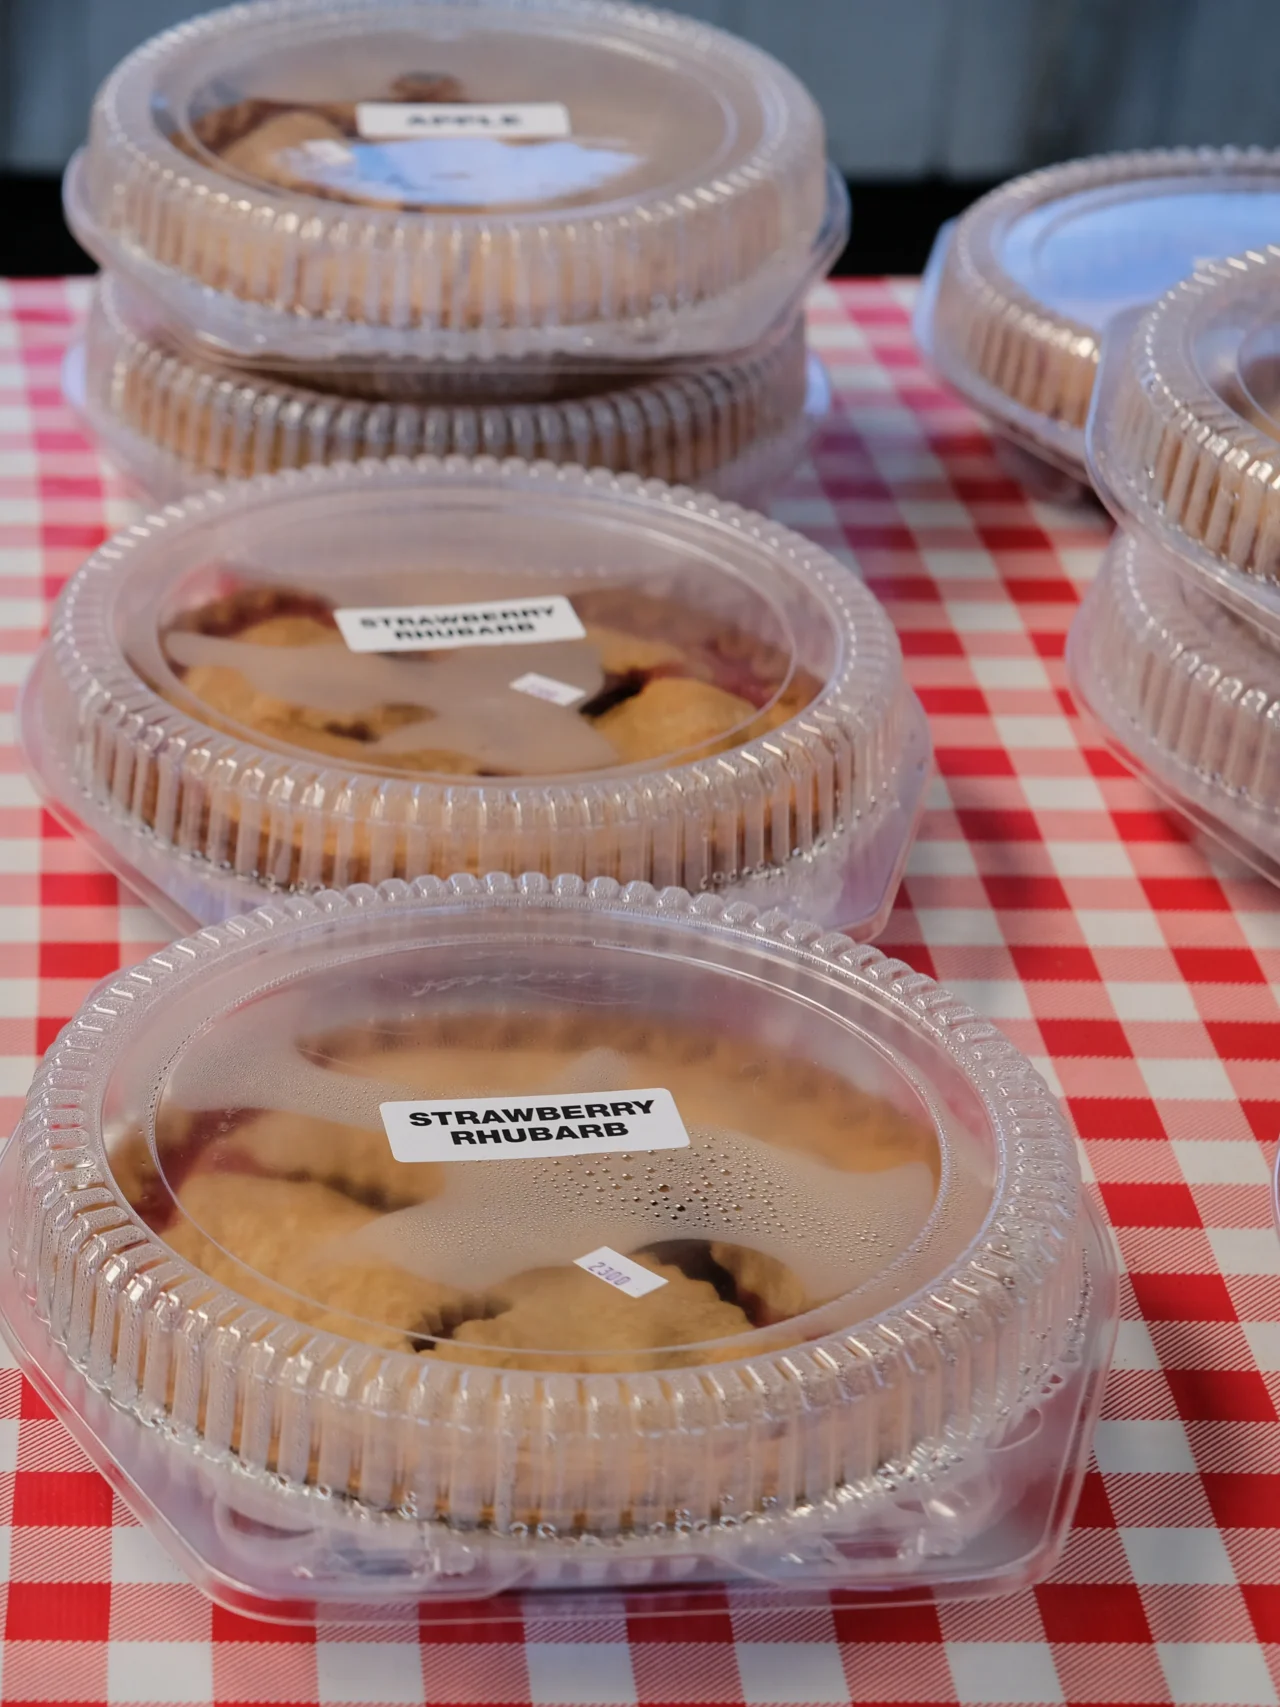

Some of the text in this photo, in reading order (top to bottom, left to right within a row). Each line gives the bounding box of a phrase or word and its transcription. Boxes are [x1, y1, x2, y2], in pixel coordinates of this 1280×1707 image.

[406, 112, 522, 127] APPLE
[360, 605, 555, 628] STRAWBERRY
[394, 622, 537, 641] RHUBARB
[409, 1099, 655, 1127] STRAWBERRY
[450, 1122, 629, 1146] RHUBARB
[588, 1261, 631, 1286] 2300
